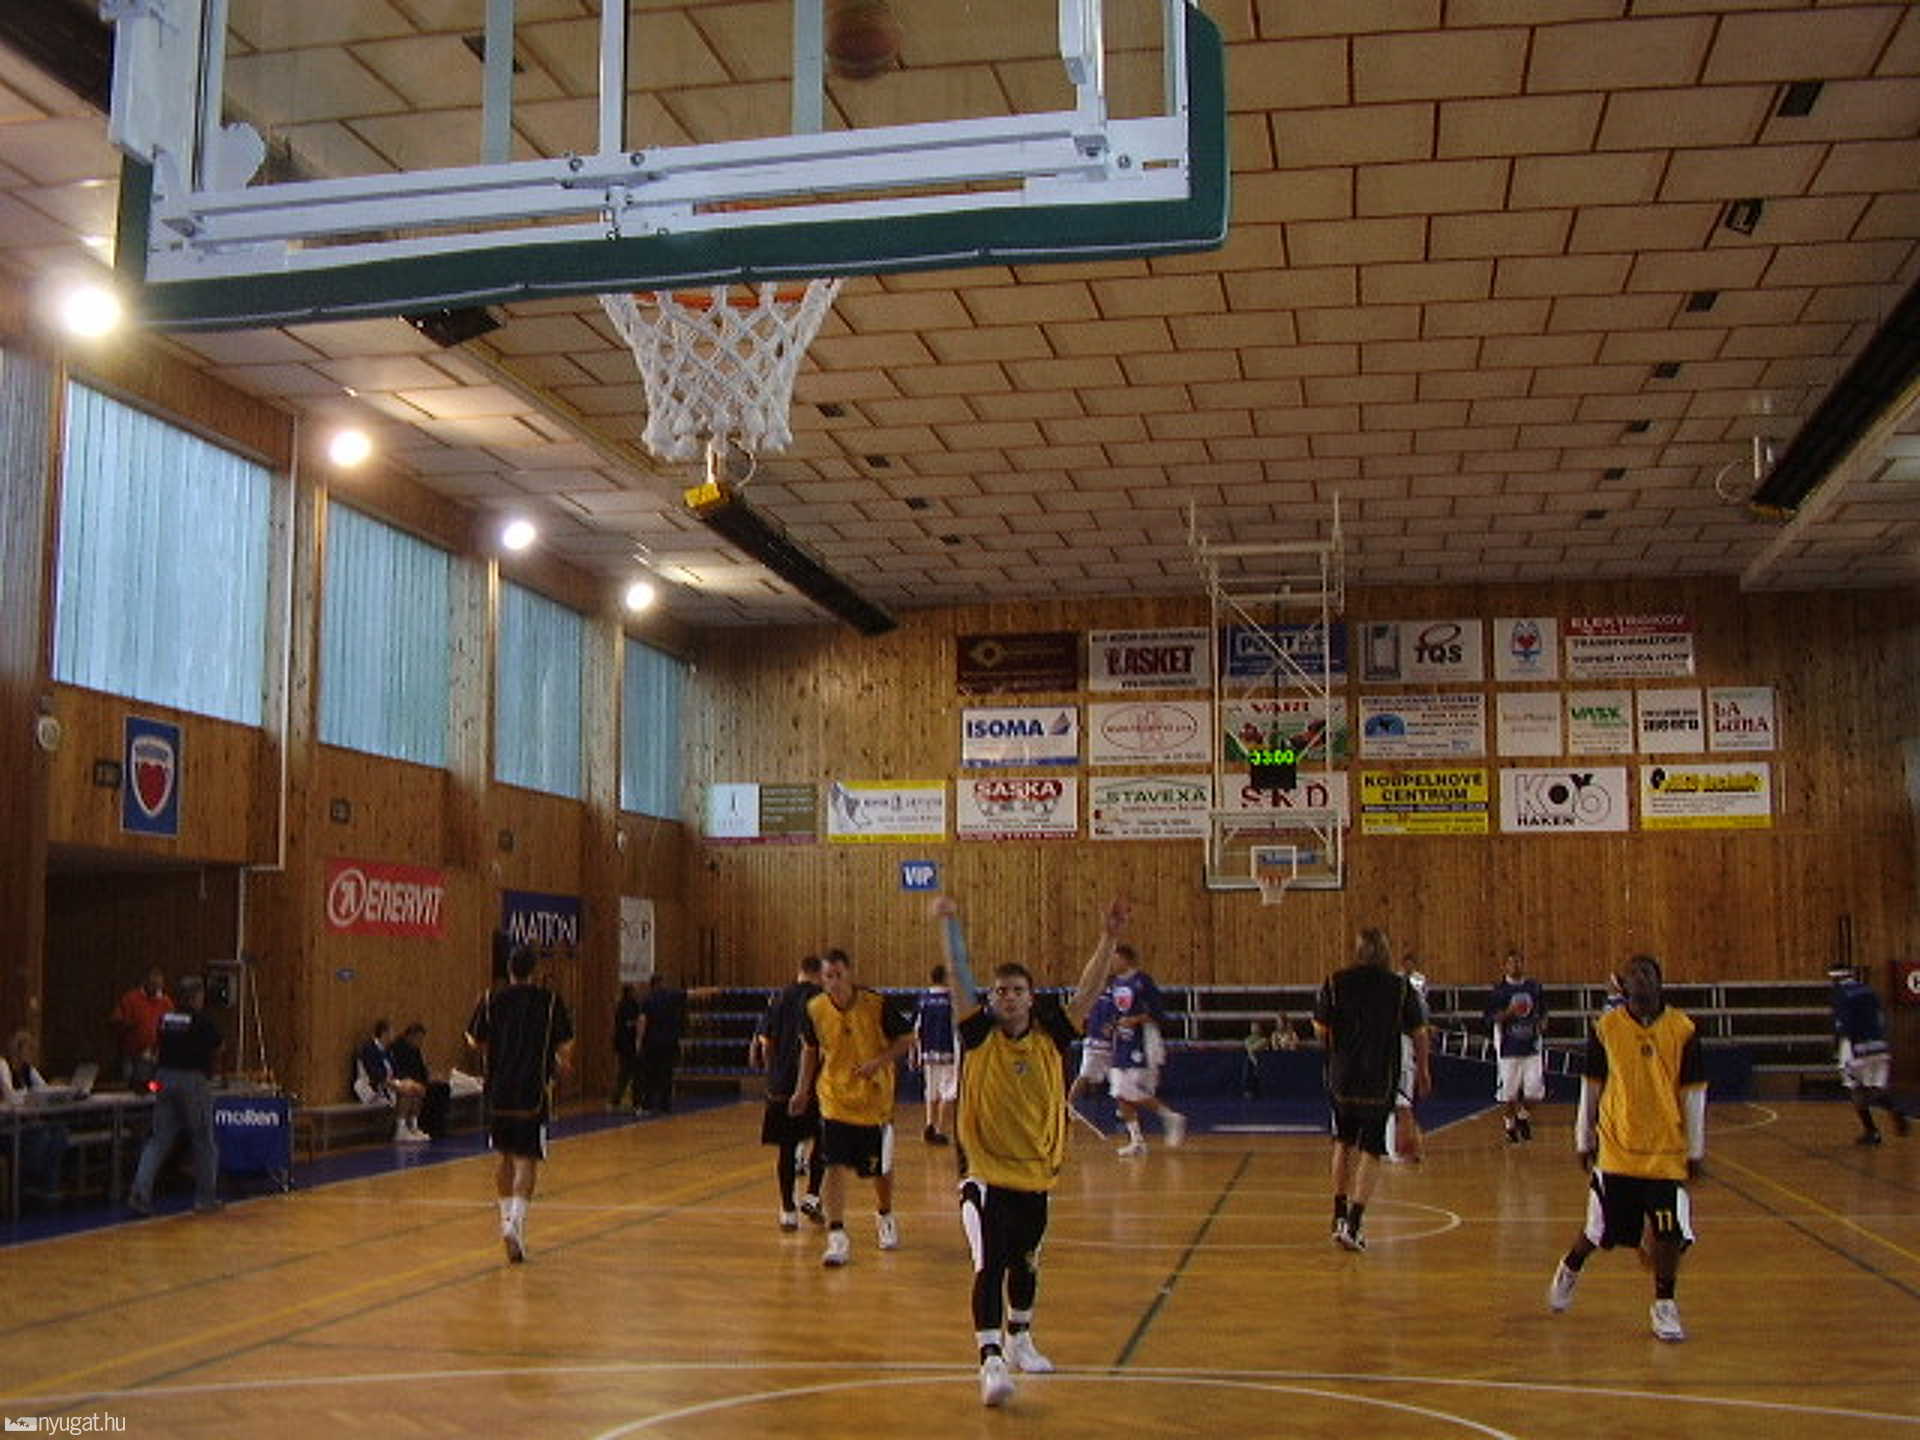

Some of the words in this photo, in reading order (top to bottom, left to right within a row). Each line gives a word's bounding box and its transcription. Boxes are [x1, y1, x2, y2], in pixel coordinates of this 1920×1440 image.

[1415, 645, 1463, 664] TQS
[967, 720, 1044, 738] ISOMA
[1106, 788, 1207, 802] STAVEXA
[1382, 788, 1468, 801] CENTRUM
[1517, 814, 1575, 826] HAKEN
[904, 866, 934, 886] VIP
[215, 1108, 280, 1127] molten
[1655, 1209, 1673, 1232] 11
